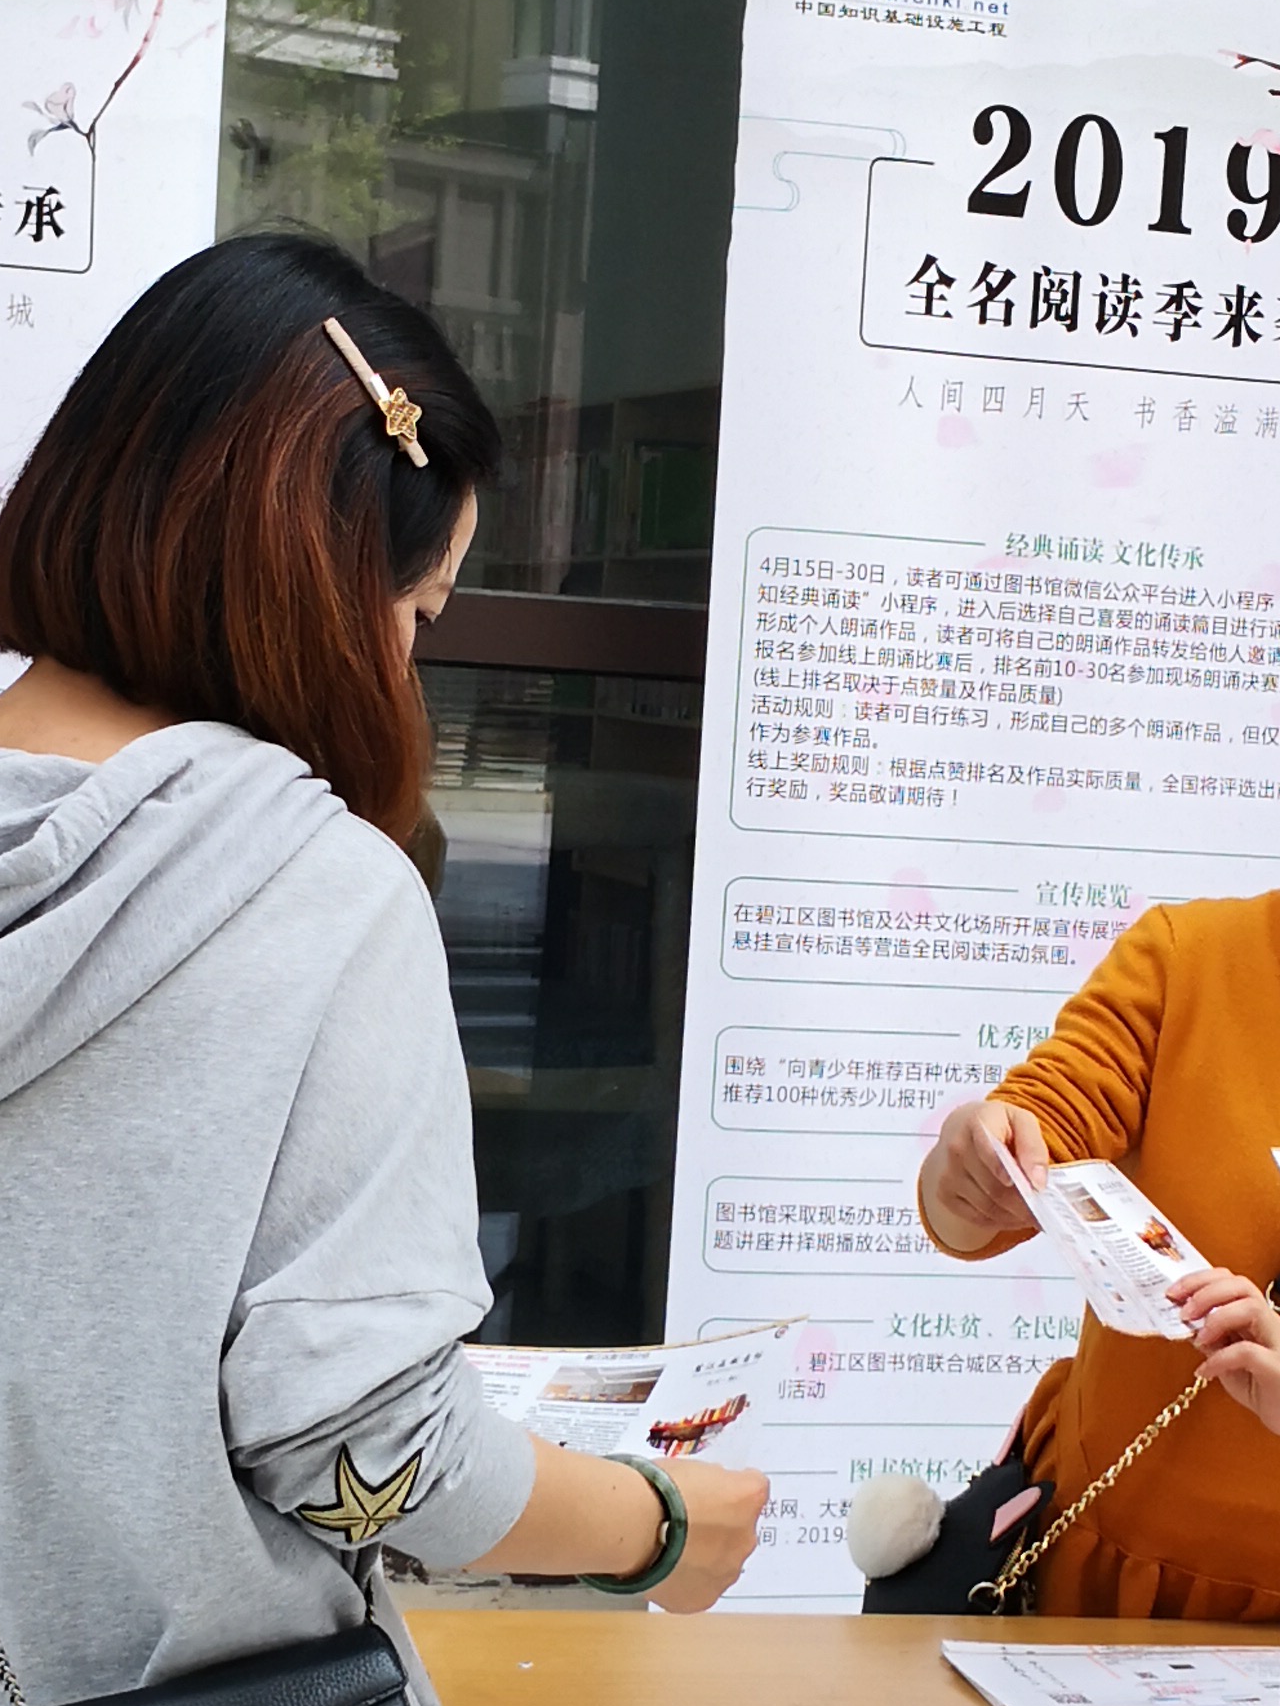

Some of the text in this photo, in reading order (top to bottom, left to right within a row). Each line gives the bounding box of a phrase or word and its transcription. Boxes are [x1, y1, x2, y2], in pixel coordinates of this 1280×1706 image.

[796, 0, 1008, 37] 中国知识基础设施工程
[1036, 881, 1132, 910] 宣传展览
[715, 1202, 921, 1226] 图书馆采取现场办理方
[779, 1379, 826, 1400] 活动
